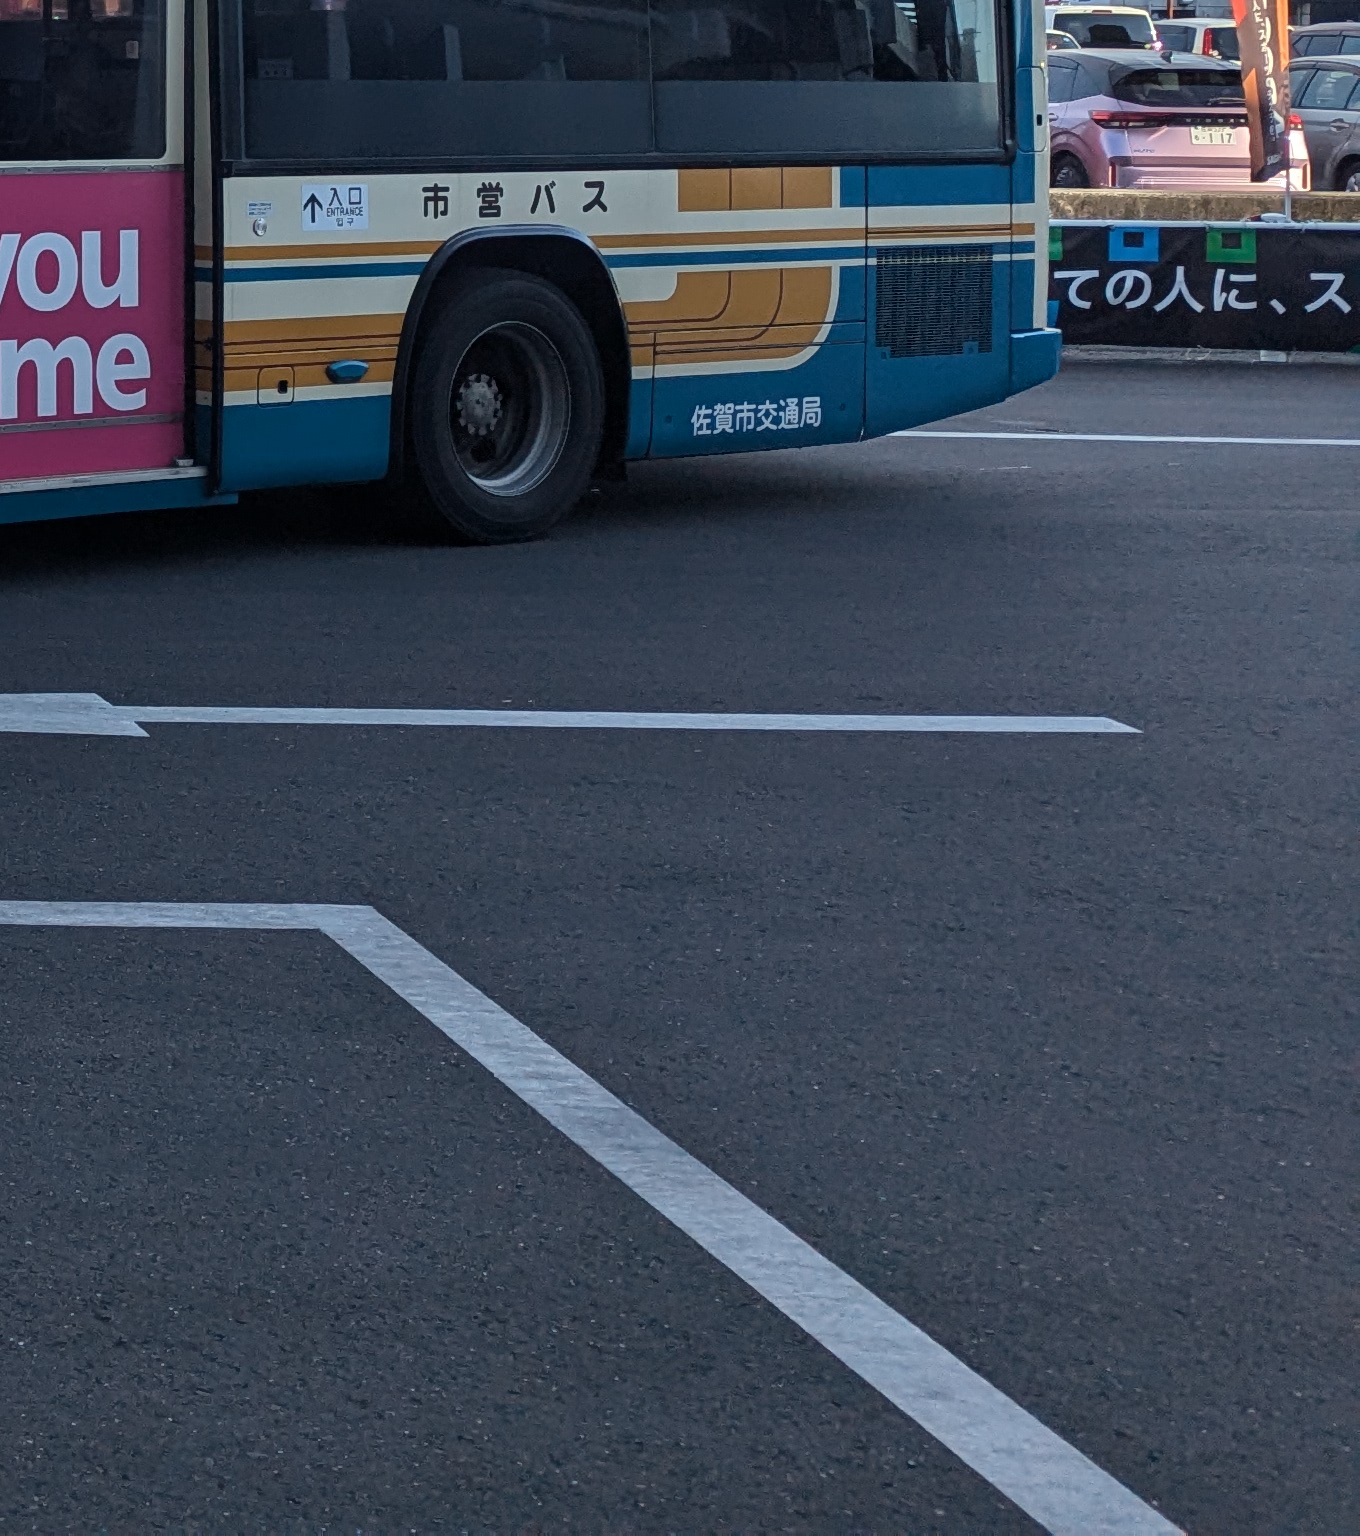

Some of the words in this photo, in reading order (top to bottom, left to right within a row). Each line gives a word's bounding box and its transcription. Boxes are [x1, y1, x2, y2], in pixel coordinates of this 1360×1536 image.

[326, 206, 364, 218] ENTRANCE
[328, 187, 363, 207] 入口
[421, 180, 608, 219] 市営バス
[0, 333, 151, 419] me
[691, 396, 822, 437] 佐賀市交通局
